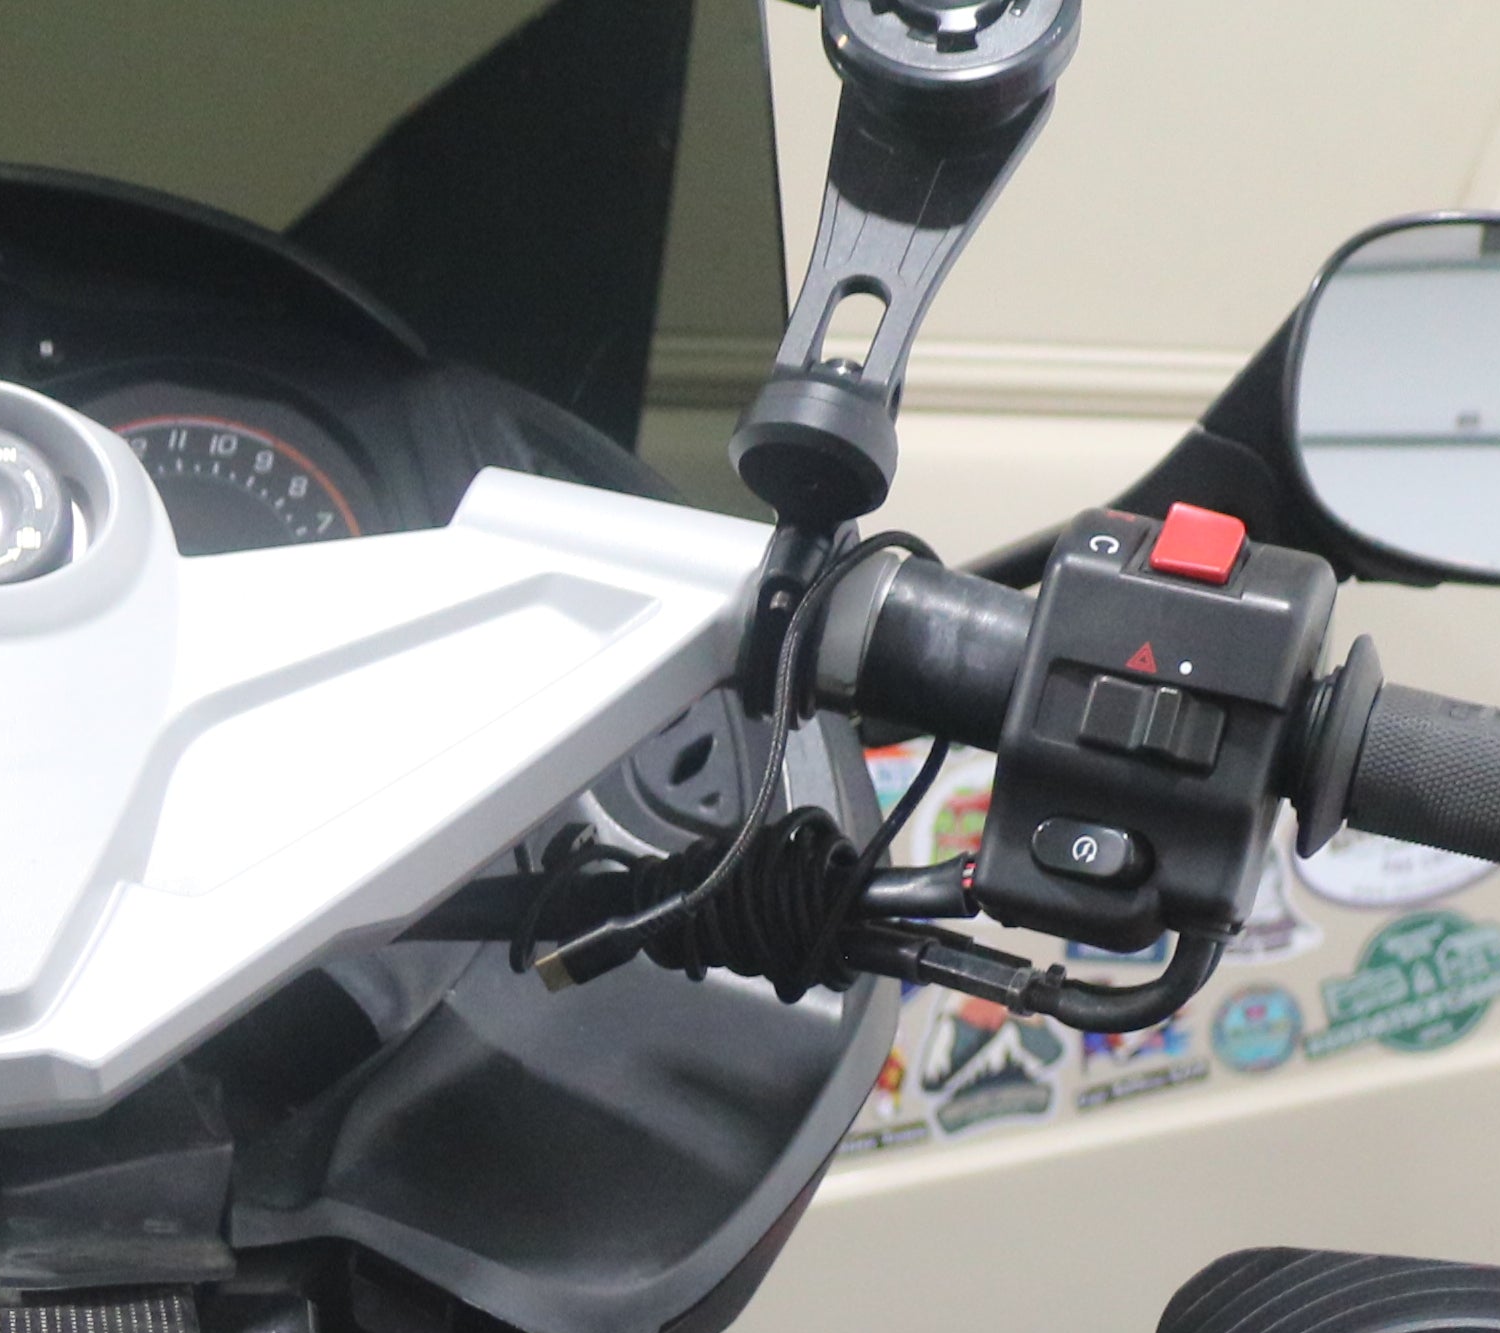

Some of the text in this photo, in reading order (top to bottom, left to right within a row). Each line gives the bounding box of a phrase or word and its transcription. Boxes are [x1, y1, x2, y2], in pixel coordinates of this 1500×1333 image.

[168, 428, 188, 450] 11
[208, 433, 239, 456] 10
[288, 475, 309, 498] 8
[316, 511, 335, 534] 7
